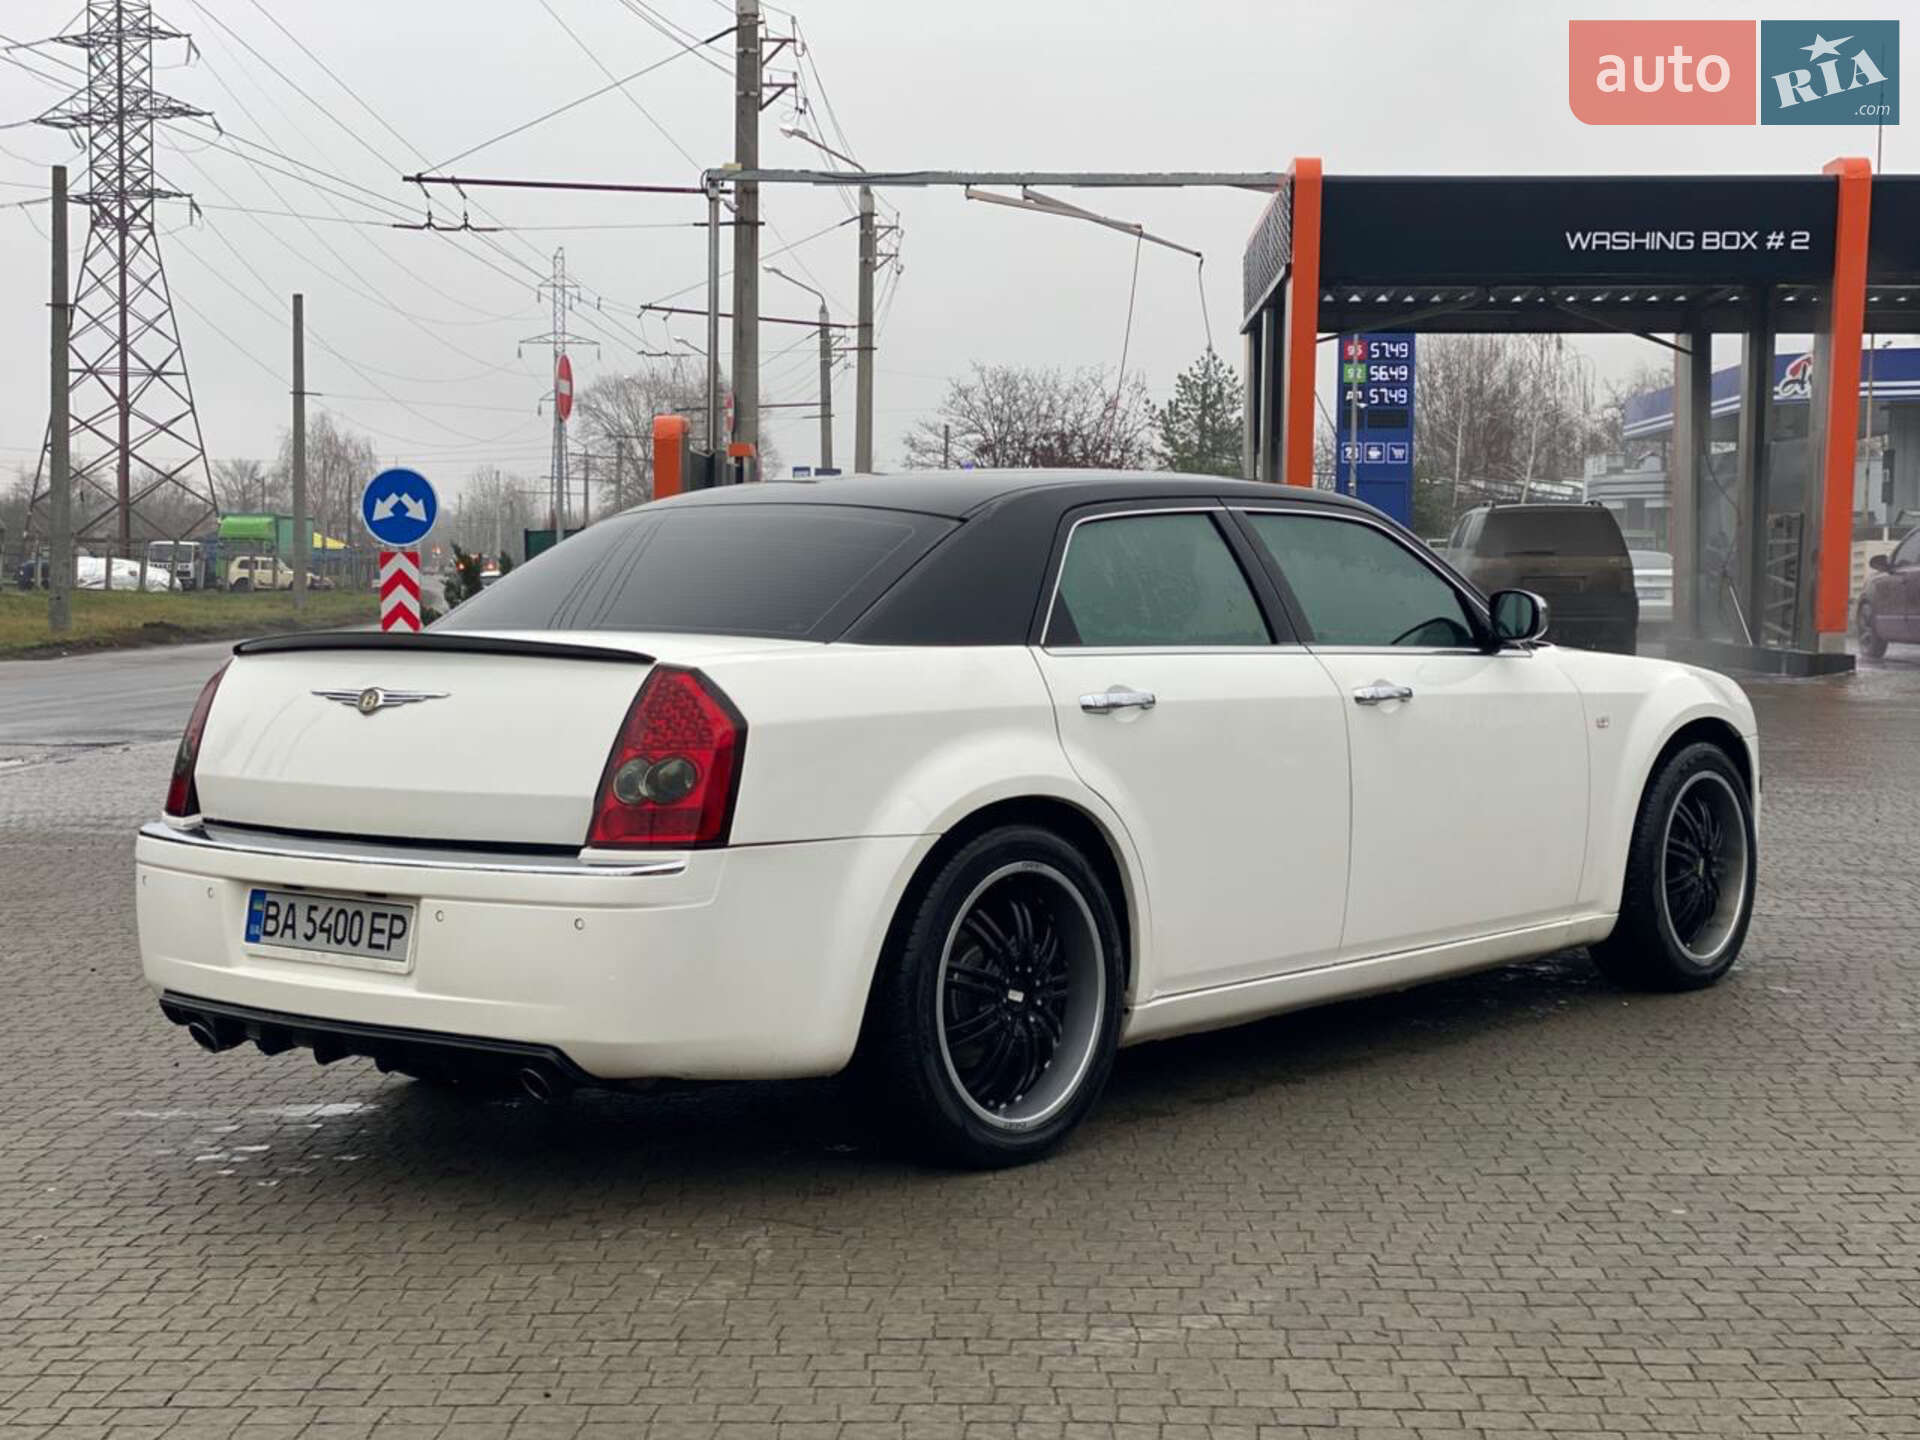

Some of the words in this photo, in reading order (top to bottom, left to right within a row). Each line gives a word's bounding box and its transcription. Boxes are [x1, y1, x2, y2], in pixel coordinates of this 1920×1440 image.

[1565, 231, 1695, 250] WASHING
[1702, 231, 1759, 250] BOX
[1766, 231, 1785, 250] #
[1790, 231, 1810, 250] 2
[262, 901, 297, 940] BA
[303, 904, 364, 946] 5400
[367, 912, 408, 951] EP
